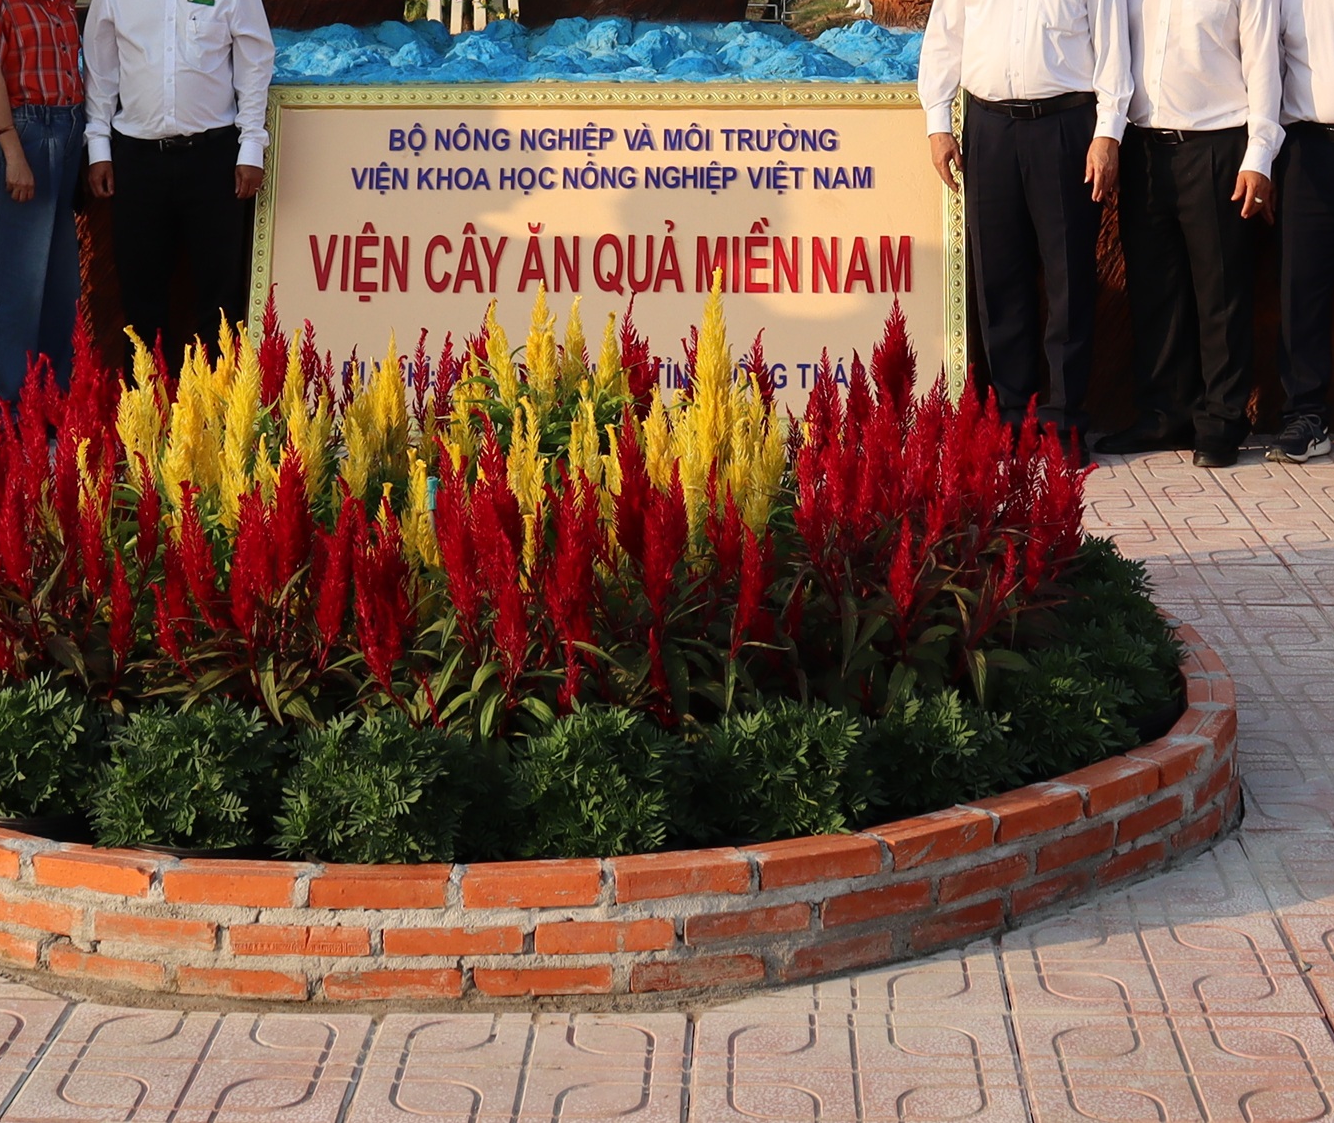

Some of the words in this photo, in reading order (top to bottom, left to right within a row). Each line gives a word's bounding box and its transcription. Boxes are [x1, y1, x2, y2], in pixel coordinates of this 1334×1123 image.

[389, 123, 427, 156] BỘ
[434, 123, 511, 152] NÔNG
[520, 122, 615, 157] NGHIỆP
[623, 123, 655, 152] VÀ
[663, 123, 711, 152] MÔI
[720, 123, 838, 152] TRƯỜNG
[351, 162, 409, 195] VIỆN
[417, 167, 491, 191] KHOA
[499, 167, 555, 195] HỌC
[562, 161, 638, 190] NÔNG
[644, 161, 738, 195] NGHIỆP
[747, 161, 805, 195] VIỆT
[813, 166, 873, 190] NAM
[309, 222, 409, 302] VIỆN
[424, 222, 508, 293] CÂY
[517, 222, 579, 293] ĂN
[593, 220, 684, 296] QUẢ
[695, 217, 799, 293] MIỀN
[811, 235, 912, 293] NAM
